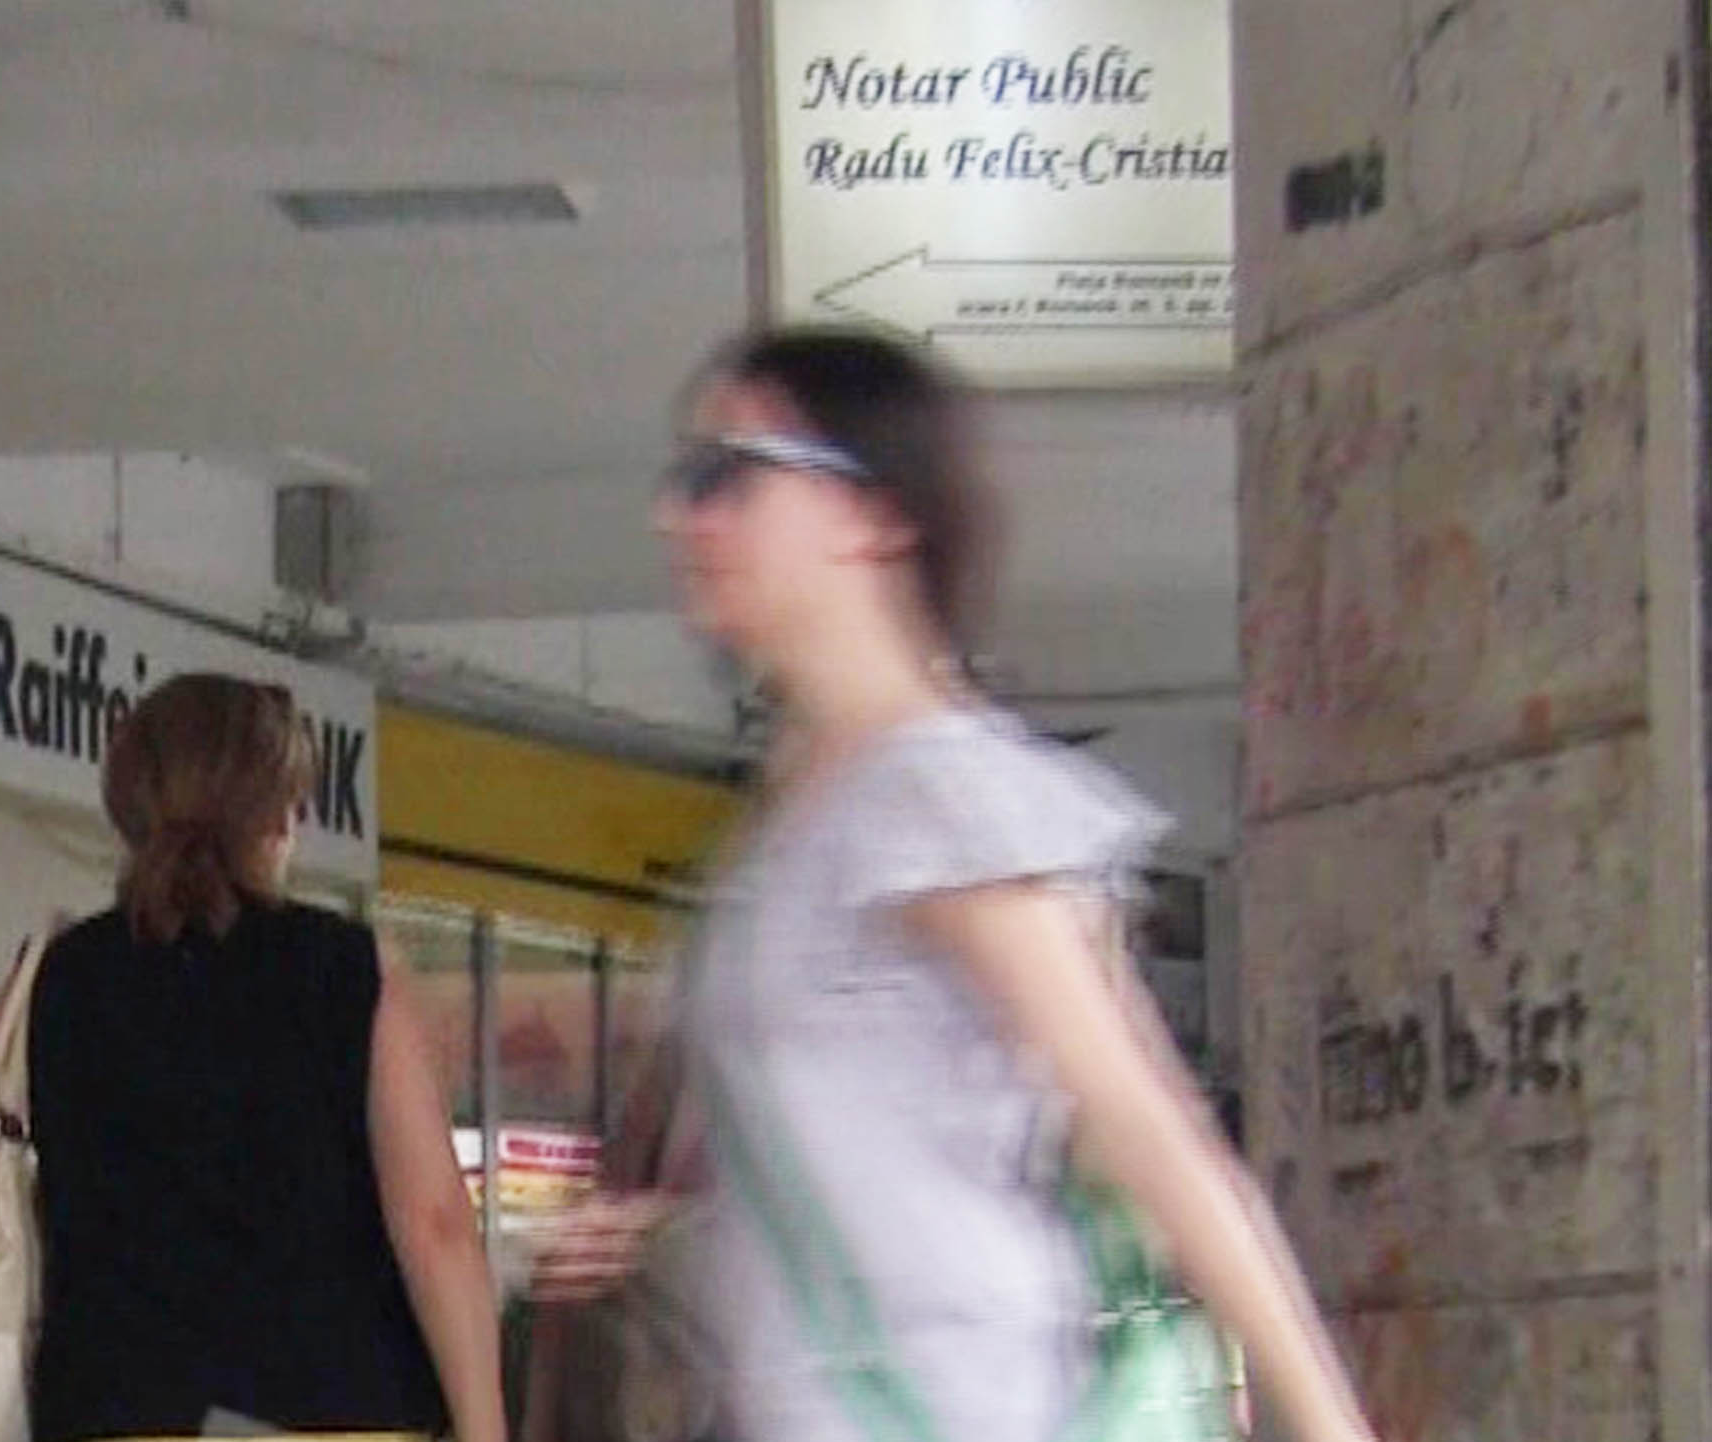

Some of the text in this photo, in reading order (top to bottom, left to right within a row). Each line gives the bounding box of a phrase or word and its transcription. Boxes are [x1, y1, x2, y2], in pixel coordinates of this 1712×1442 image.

[800, 45, 1153, 110] Notar Public
[804, 131, 928, 190] Radu
